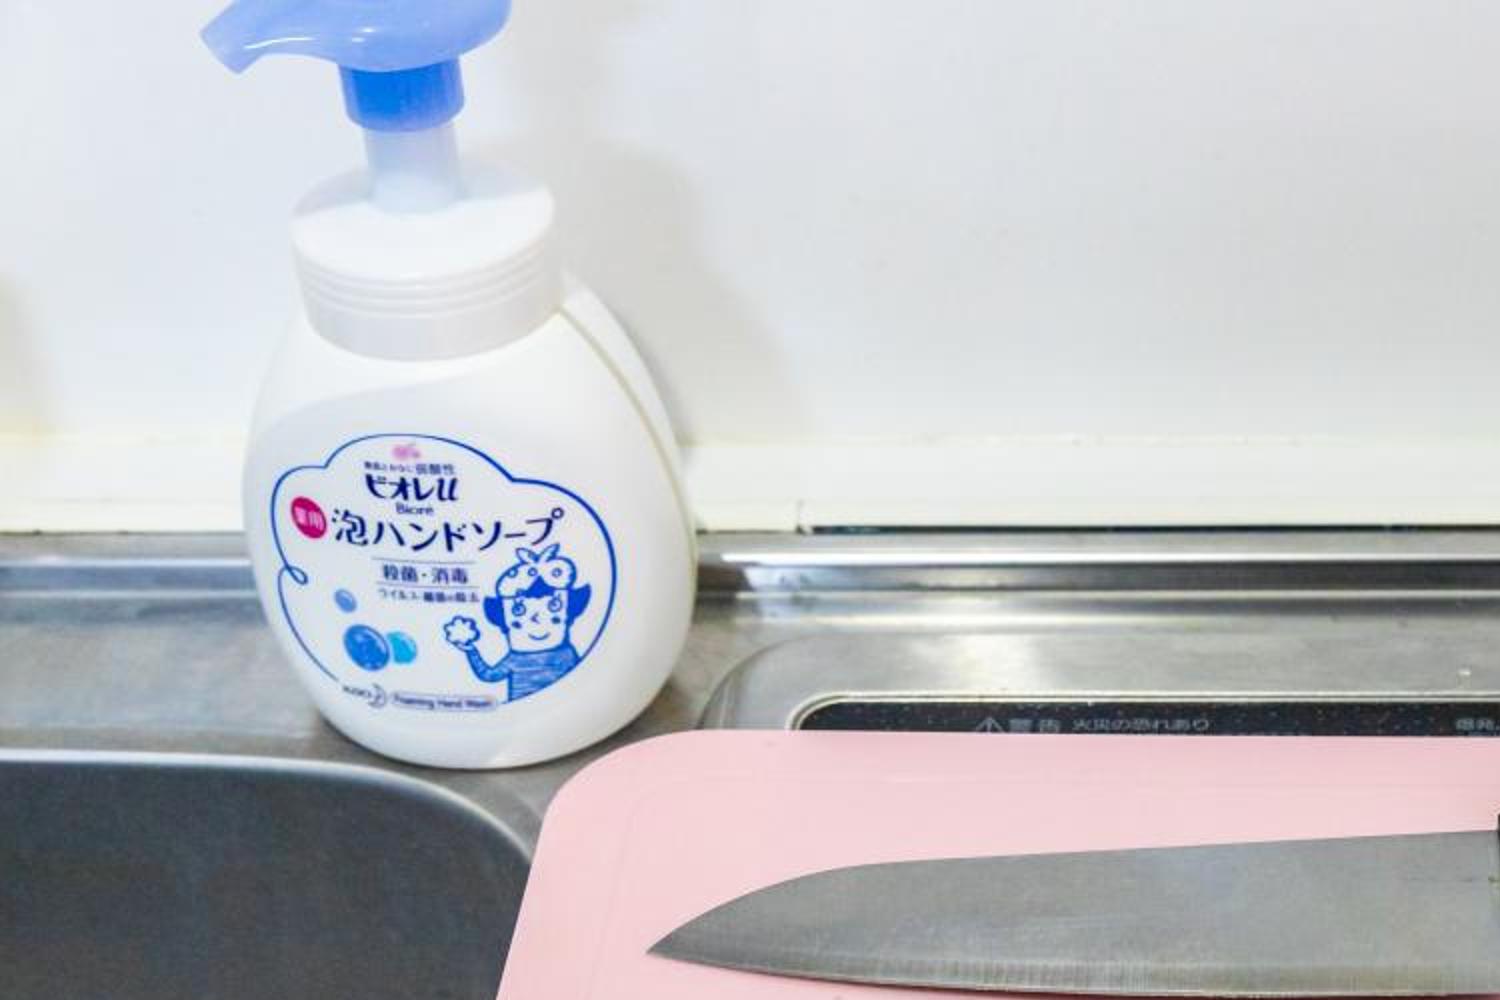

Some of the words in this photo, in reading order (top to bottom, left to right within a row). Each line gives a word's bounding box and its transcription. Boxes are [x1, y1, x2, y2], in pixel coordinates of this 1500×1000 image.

[331, 507, 565, 553] 泡ハンドソープ
[383, 564, 469, 585] 殺菌・消毒
